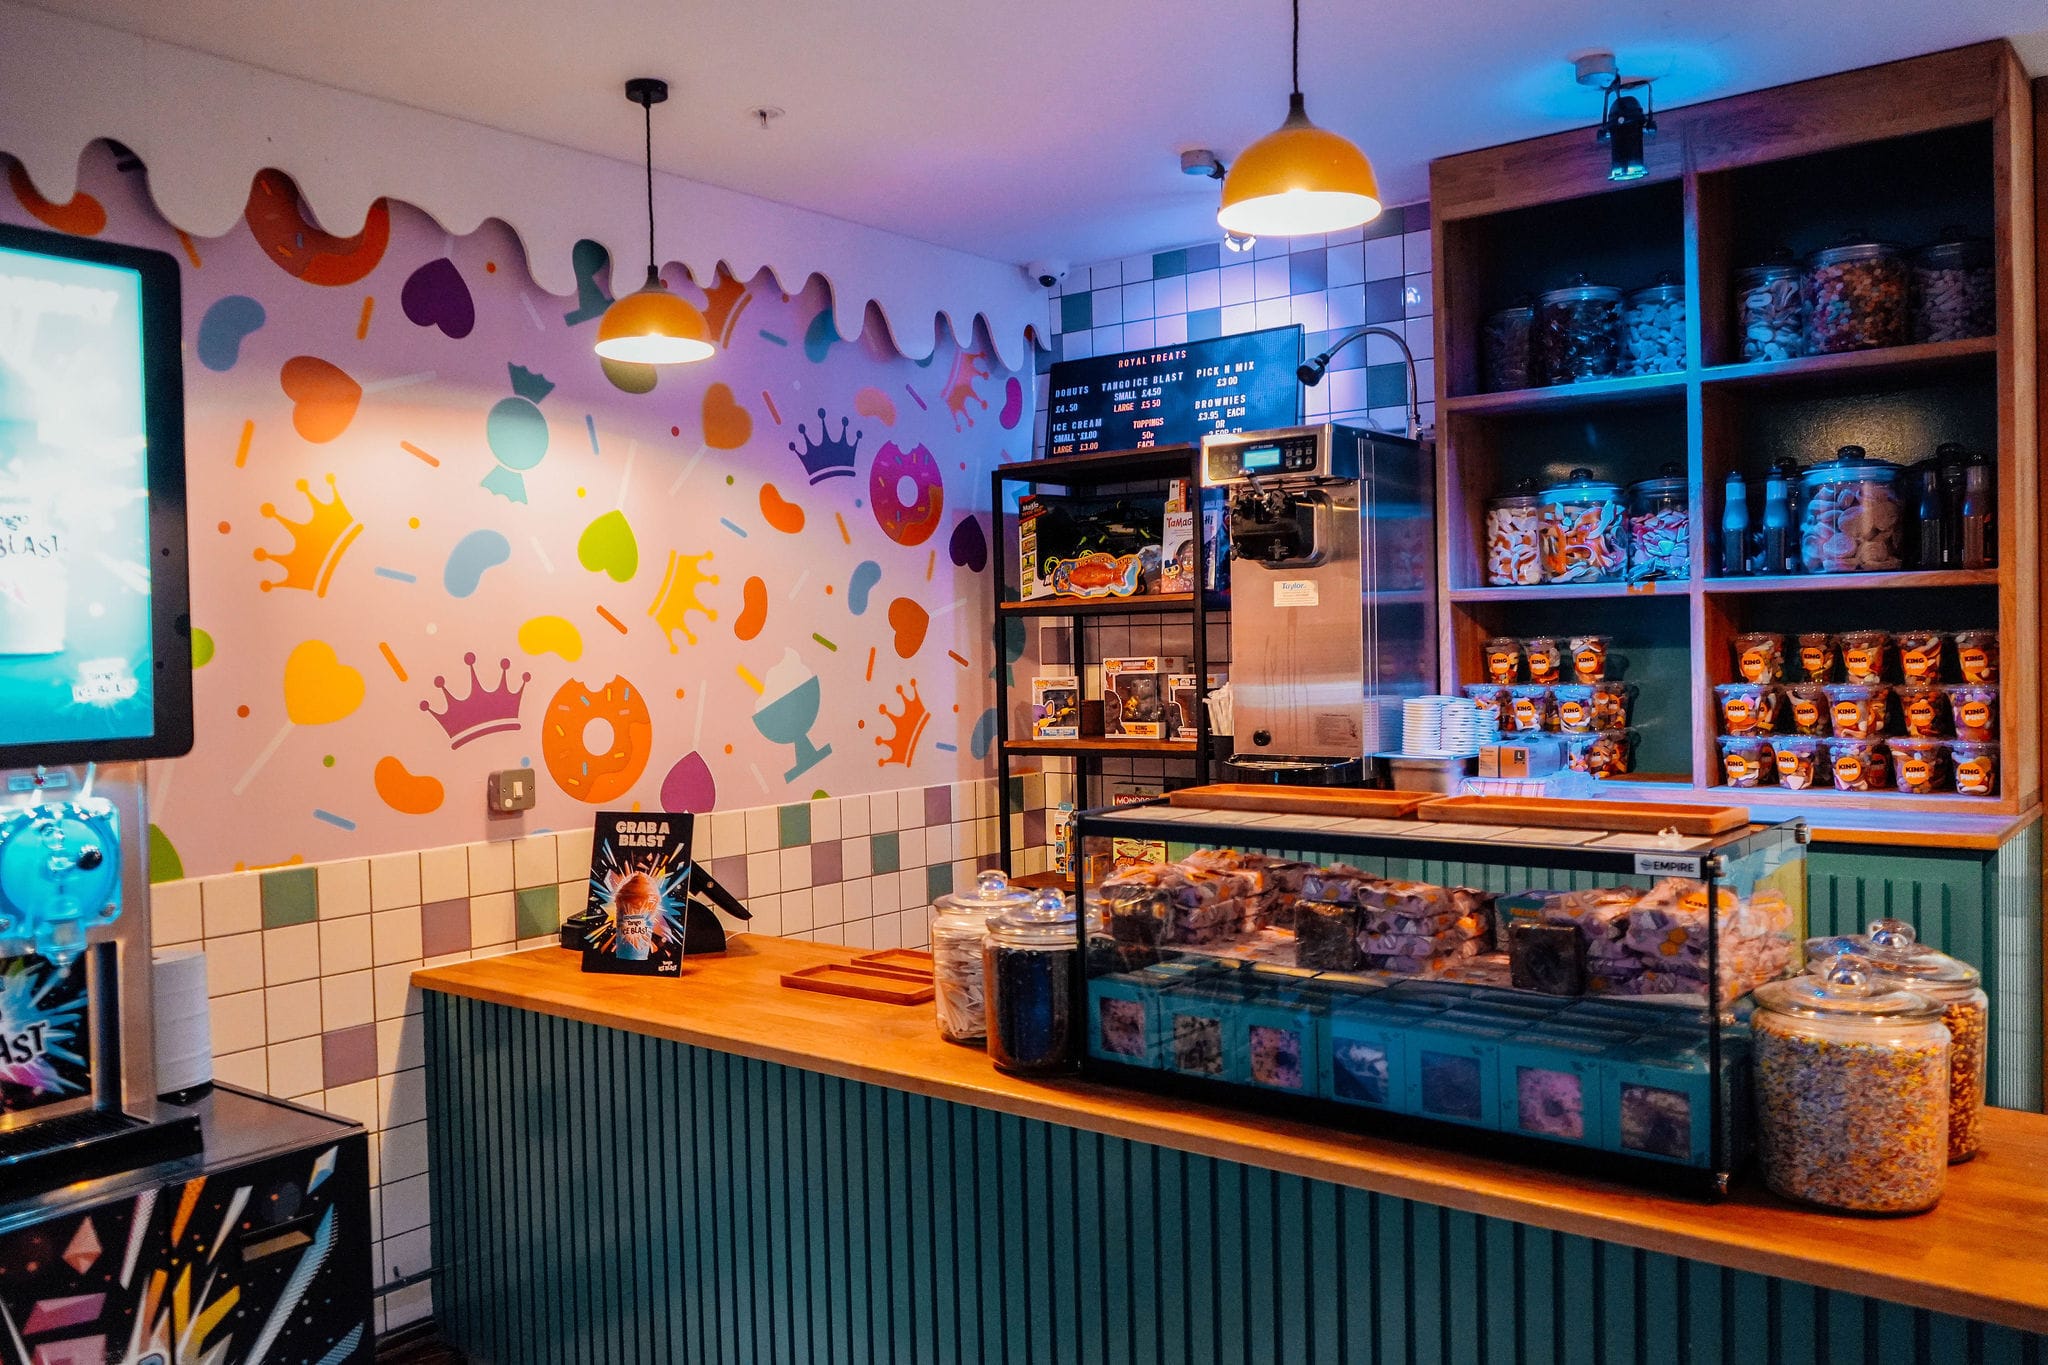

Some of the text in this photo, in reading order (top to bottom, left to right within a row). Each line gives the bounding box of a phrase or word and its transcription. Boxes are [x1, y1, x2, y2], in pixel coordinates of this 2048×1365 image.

[1118, 350, 1187, 368] ROYAL TREATS
[1196, 361, 1255, 378] PICK N MIX
[1102, 371, 1184, 392] TANGO ICE BLAST
[1055, 386, 1089, 398] DONUTS
[1114, 391, 1137, 402] SMALL
[1113, 402, 1135, 413] LARGE
[1195, 394, 1246, 409] BROWNIES
[1055, 403, 1078, 413] £4.50
[1198, 407, 1246, 421] £3.95 EACH
[1053, 418, 1102, 432] ICE CREAM
[1133, 417, 1164, 429] TOPPINGS
[1215, 419, 1226, 429] OR
[1054, 433, 1076, 443] SMALL
[1053, 445, 1073, 454] LARGE
[615, 821, 670, 834] GRAB A
[619, 834, 666, 847] BLAST
[1653, 861, 1695, 872] EMPIRE
